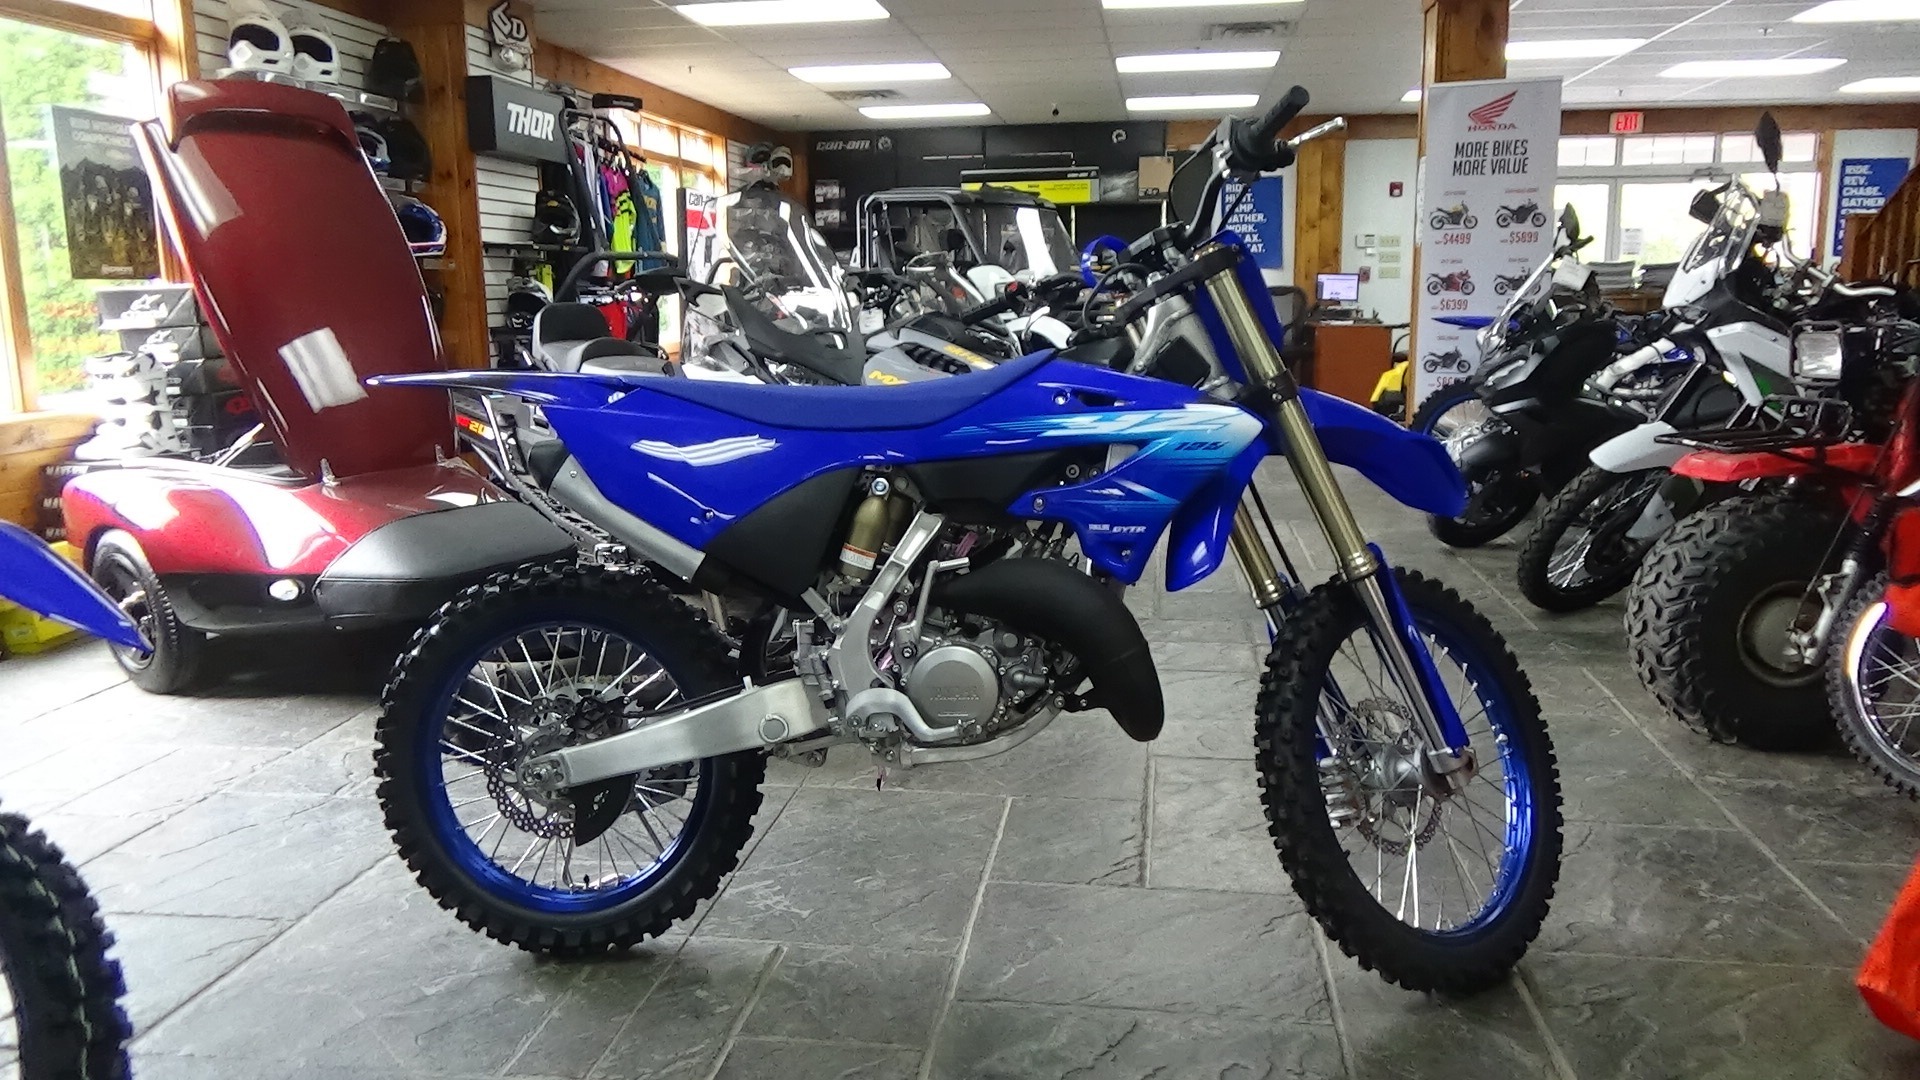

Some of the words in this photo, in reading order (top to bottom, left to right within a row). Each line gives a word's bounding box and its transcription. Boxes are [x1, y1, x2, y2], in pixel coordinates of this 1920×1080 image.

[507, 102, 556, 142] THOR
[1467, 122, 1517, 132] HONDA
[1615, 112, 1639, 131] EXIT
[1454, 141, 1489, 159] MORE
[1492, 139, 1529, 157] BIKES
[1452, 159, 1489, 177] MORE
[1490, 157, 1529, 175] VALUE
